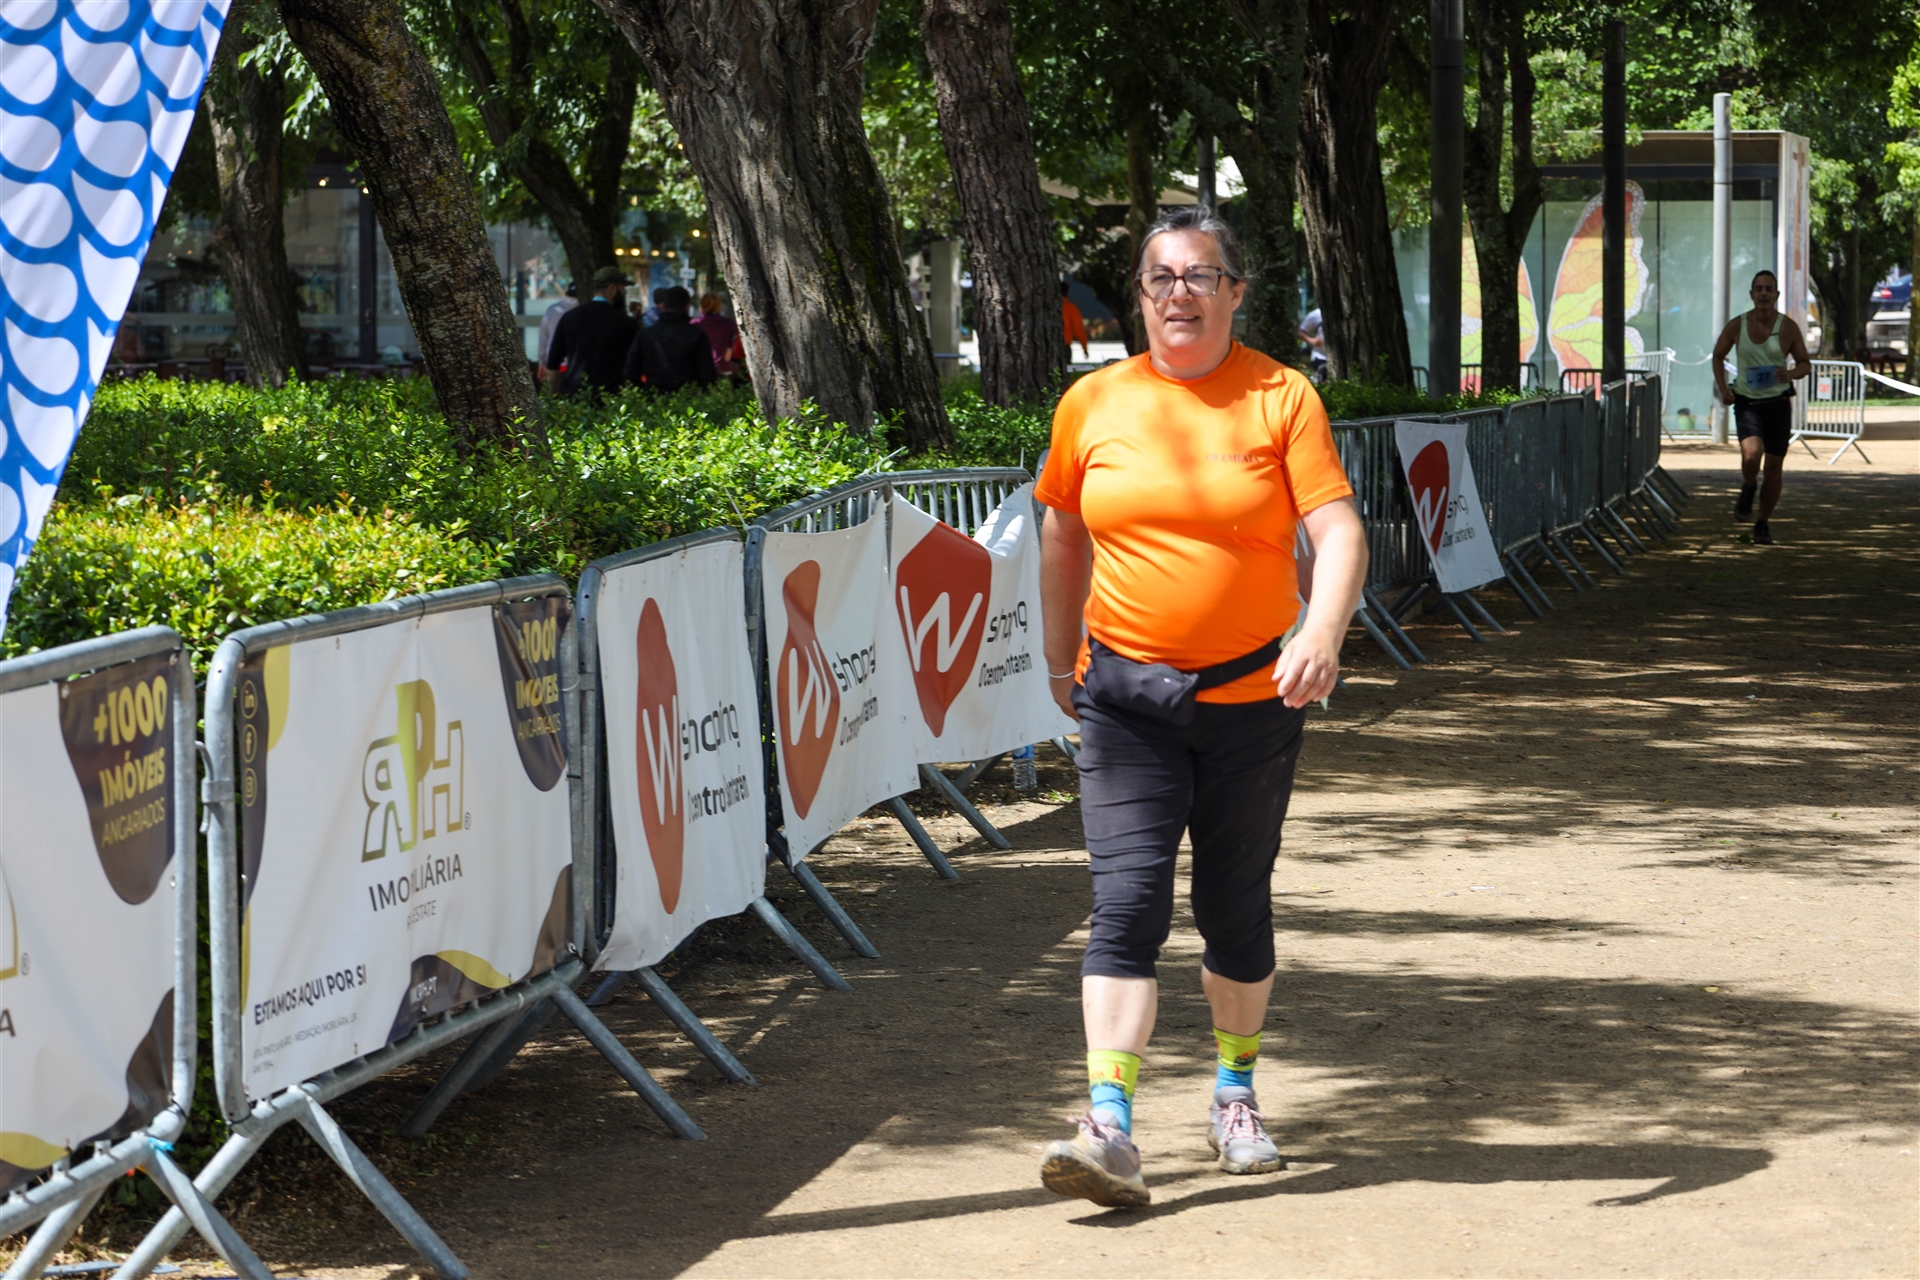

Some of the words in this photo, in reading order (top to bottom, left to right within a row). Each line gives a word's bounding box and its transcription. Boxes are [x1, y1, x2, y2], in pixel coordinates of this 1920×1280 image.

[1757, 371, 1771, 382] 27
[900, 585, 984, 673] W
[93, 675, 167, 746] +1000
[99, 746, 166, 808] IMÓVEIS
[642, 694, 680, 825] W
[101, 797, 166, 847] ANGARIADOS
[254, 988, 297, 1026] ESTAMOS
[298, 977, 326, 1007] AQUI
[325, 968, 355, 996] POR
[356, 964, 367, 986] SI
